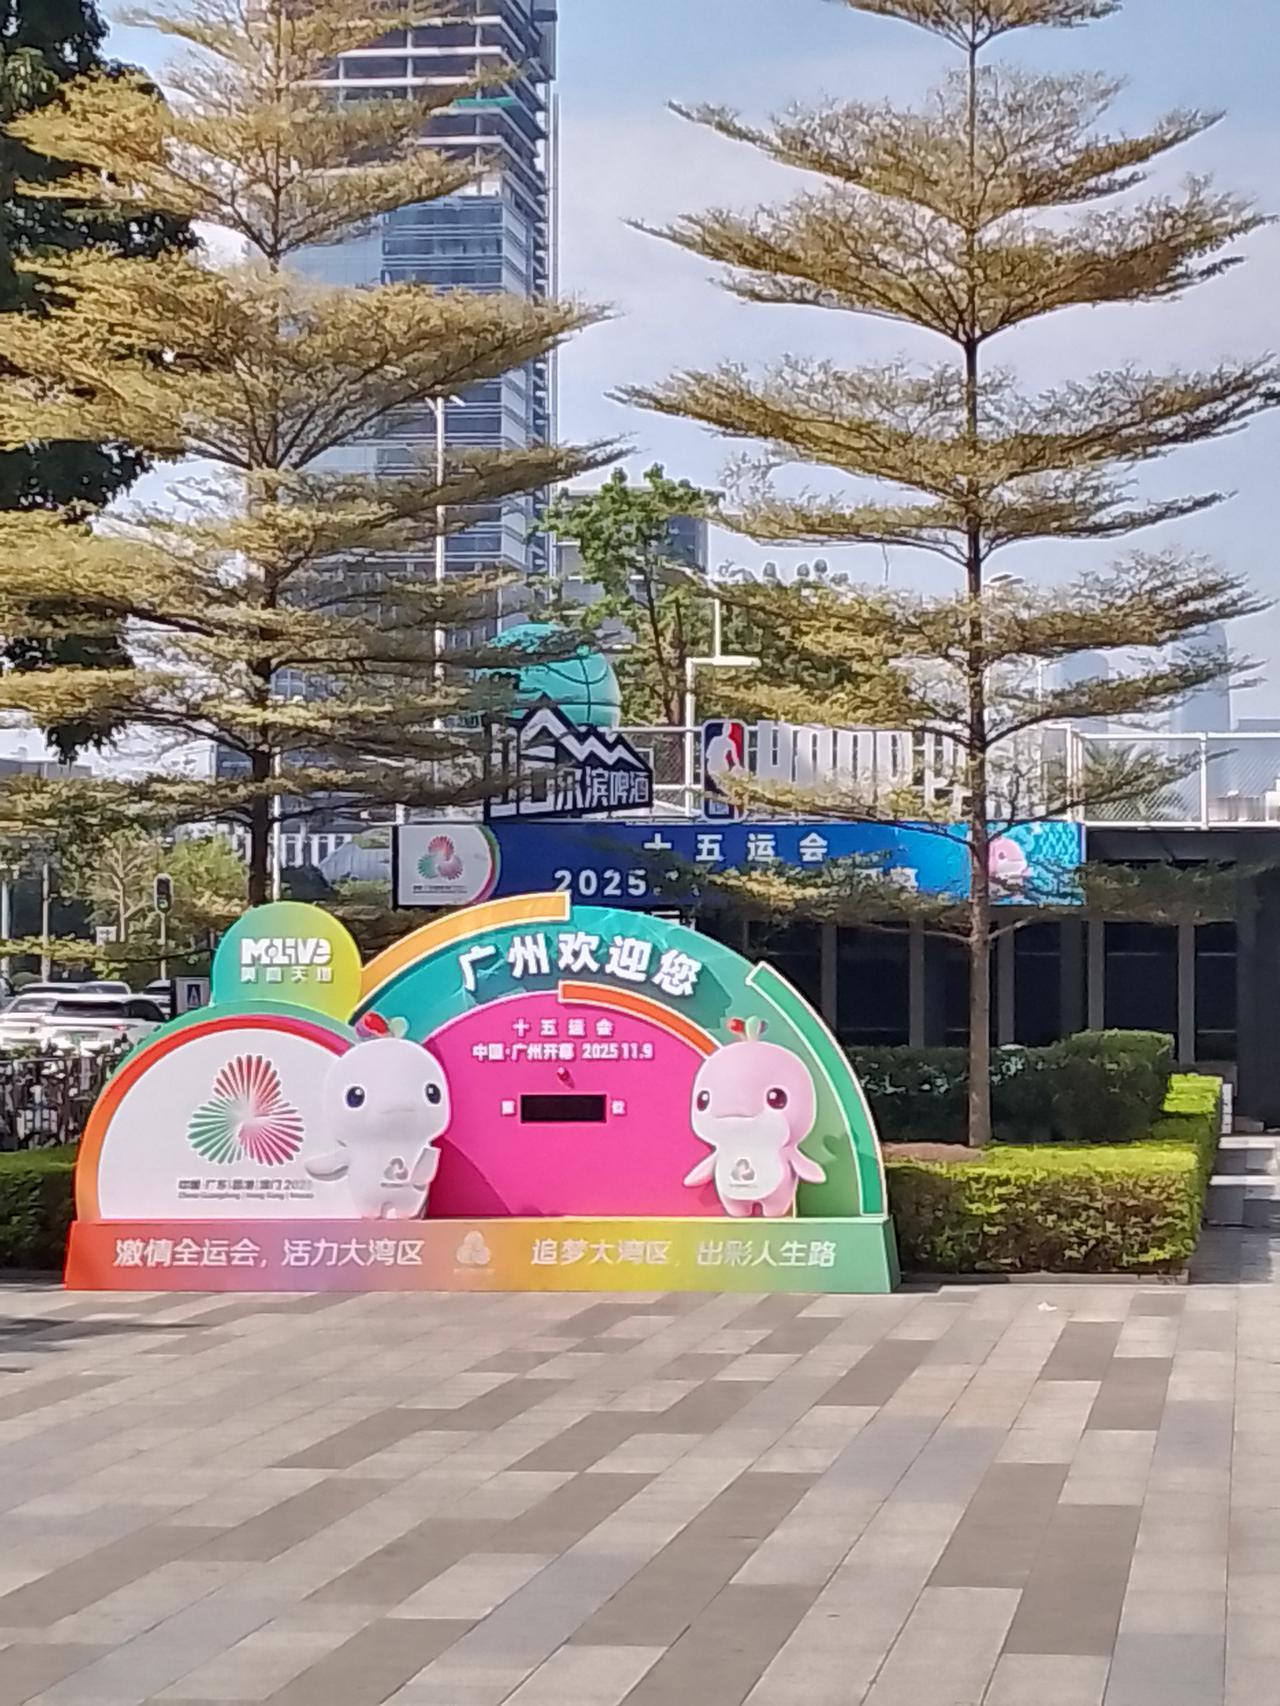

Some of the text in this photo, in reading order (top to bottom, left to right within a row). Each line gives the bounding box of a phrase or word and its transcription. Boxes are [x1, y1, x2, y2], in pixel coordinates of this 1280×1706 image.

[644, 832, 828, 862] 十五运会
[459, 931, 702, 996] 广州欢迎您
[513, 1018, 614, 1037] 十五运会
